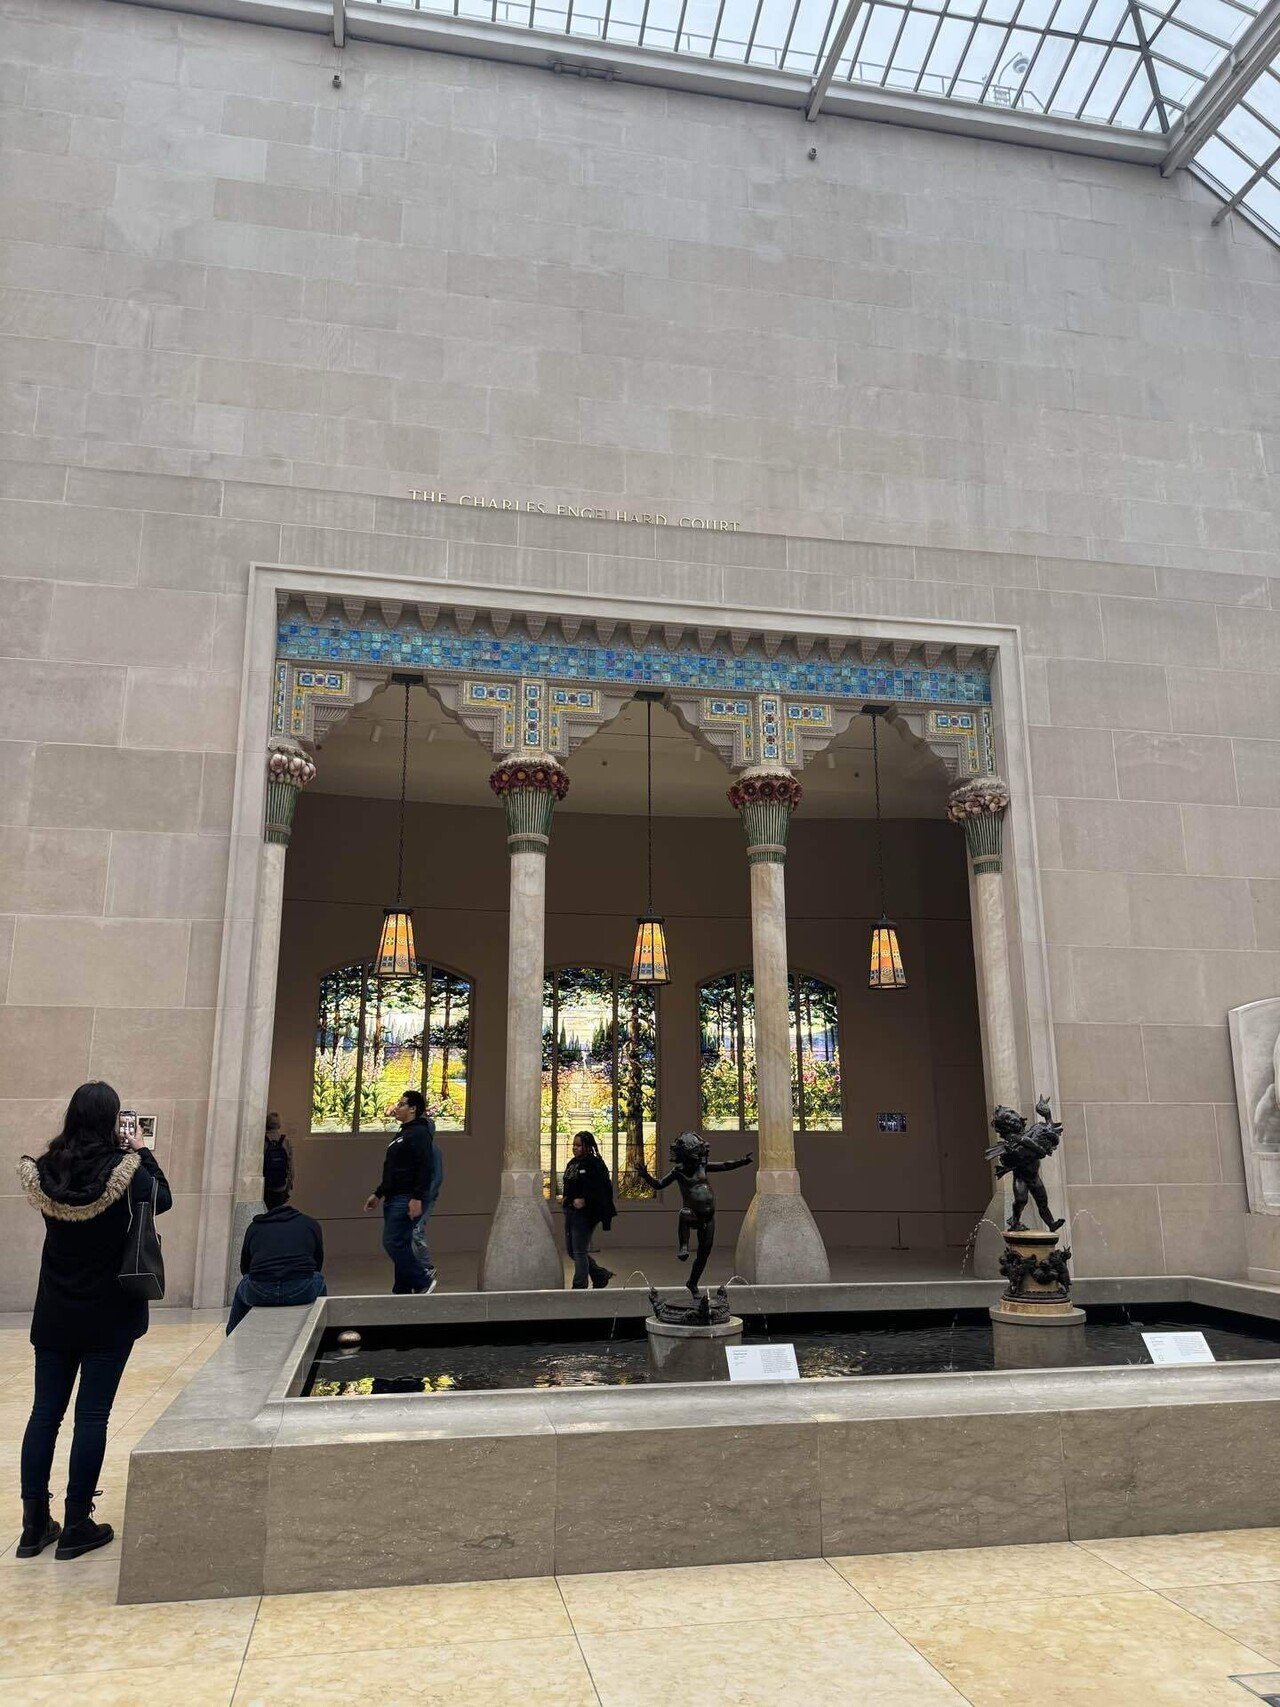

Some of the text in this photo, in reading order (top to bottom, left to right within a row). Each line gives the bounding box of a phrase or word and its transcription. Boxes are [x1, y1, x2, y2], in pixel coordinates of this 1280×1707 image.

[408, 489, 447, 503] THE
[459, 495, 546, 514] CHARLES
[679, 516, 740, 532] COURT
